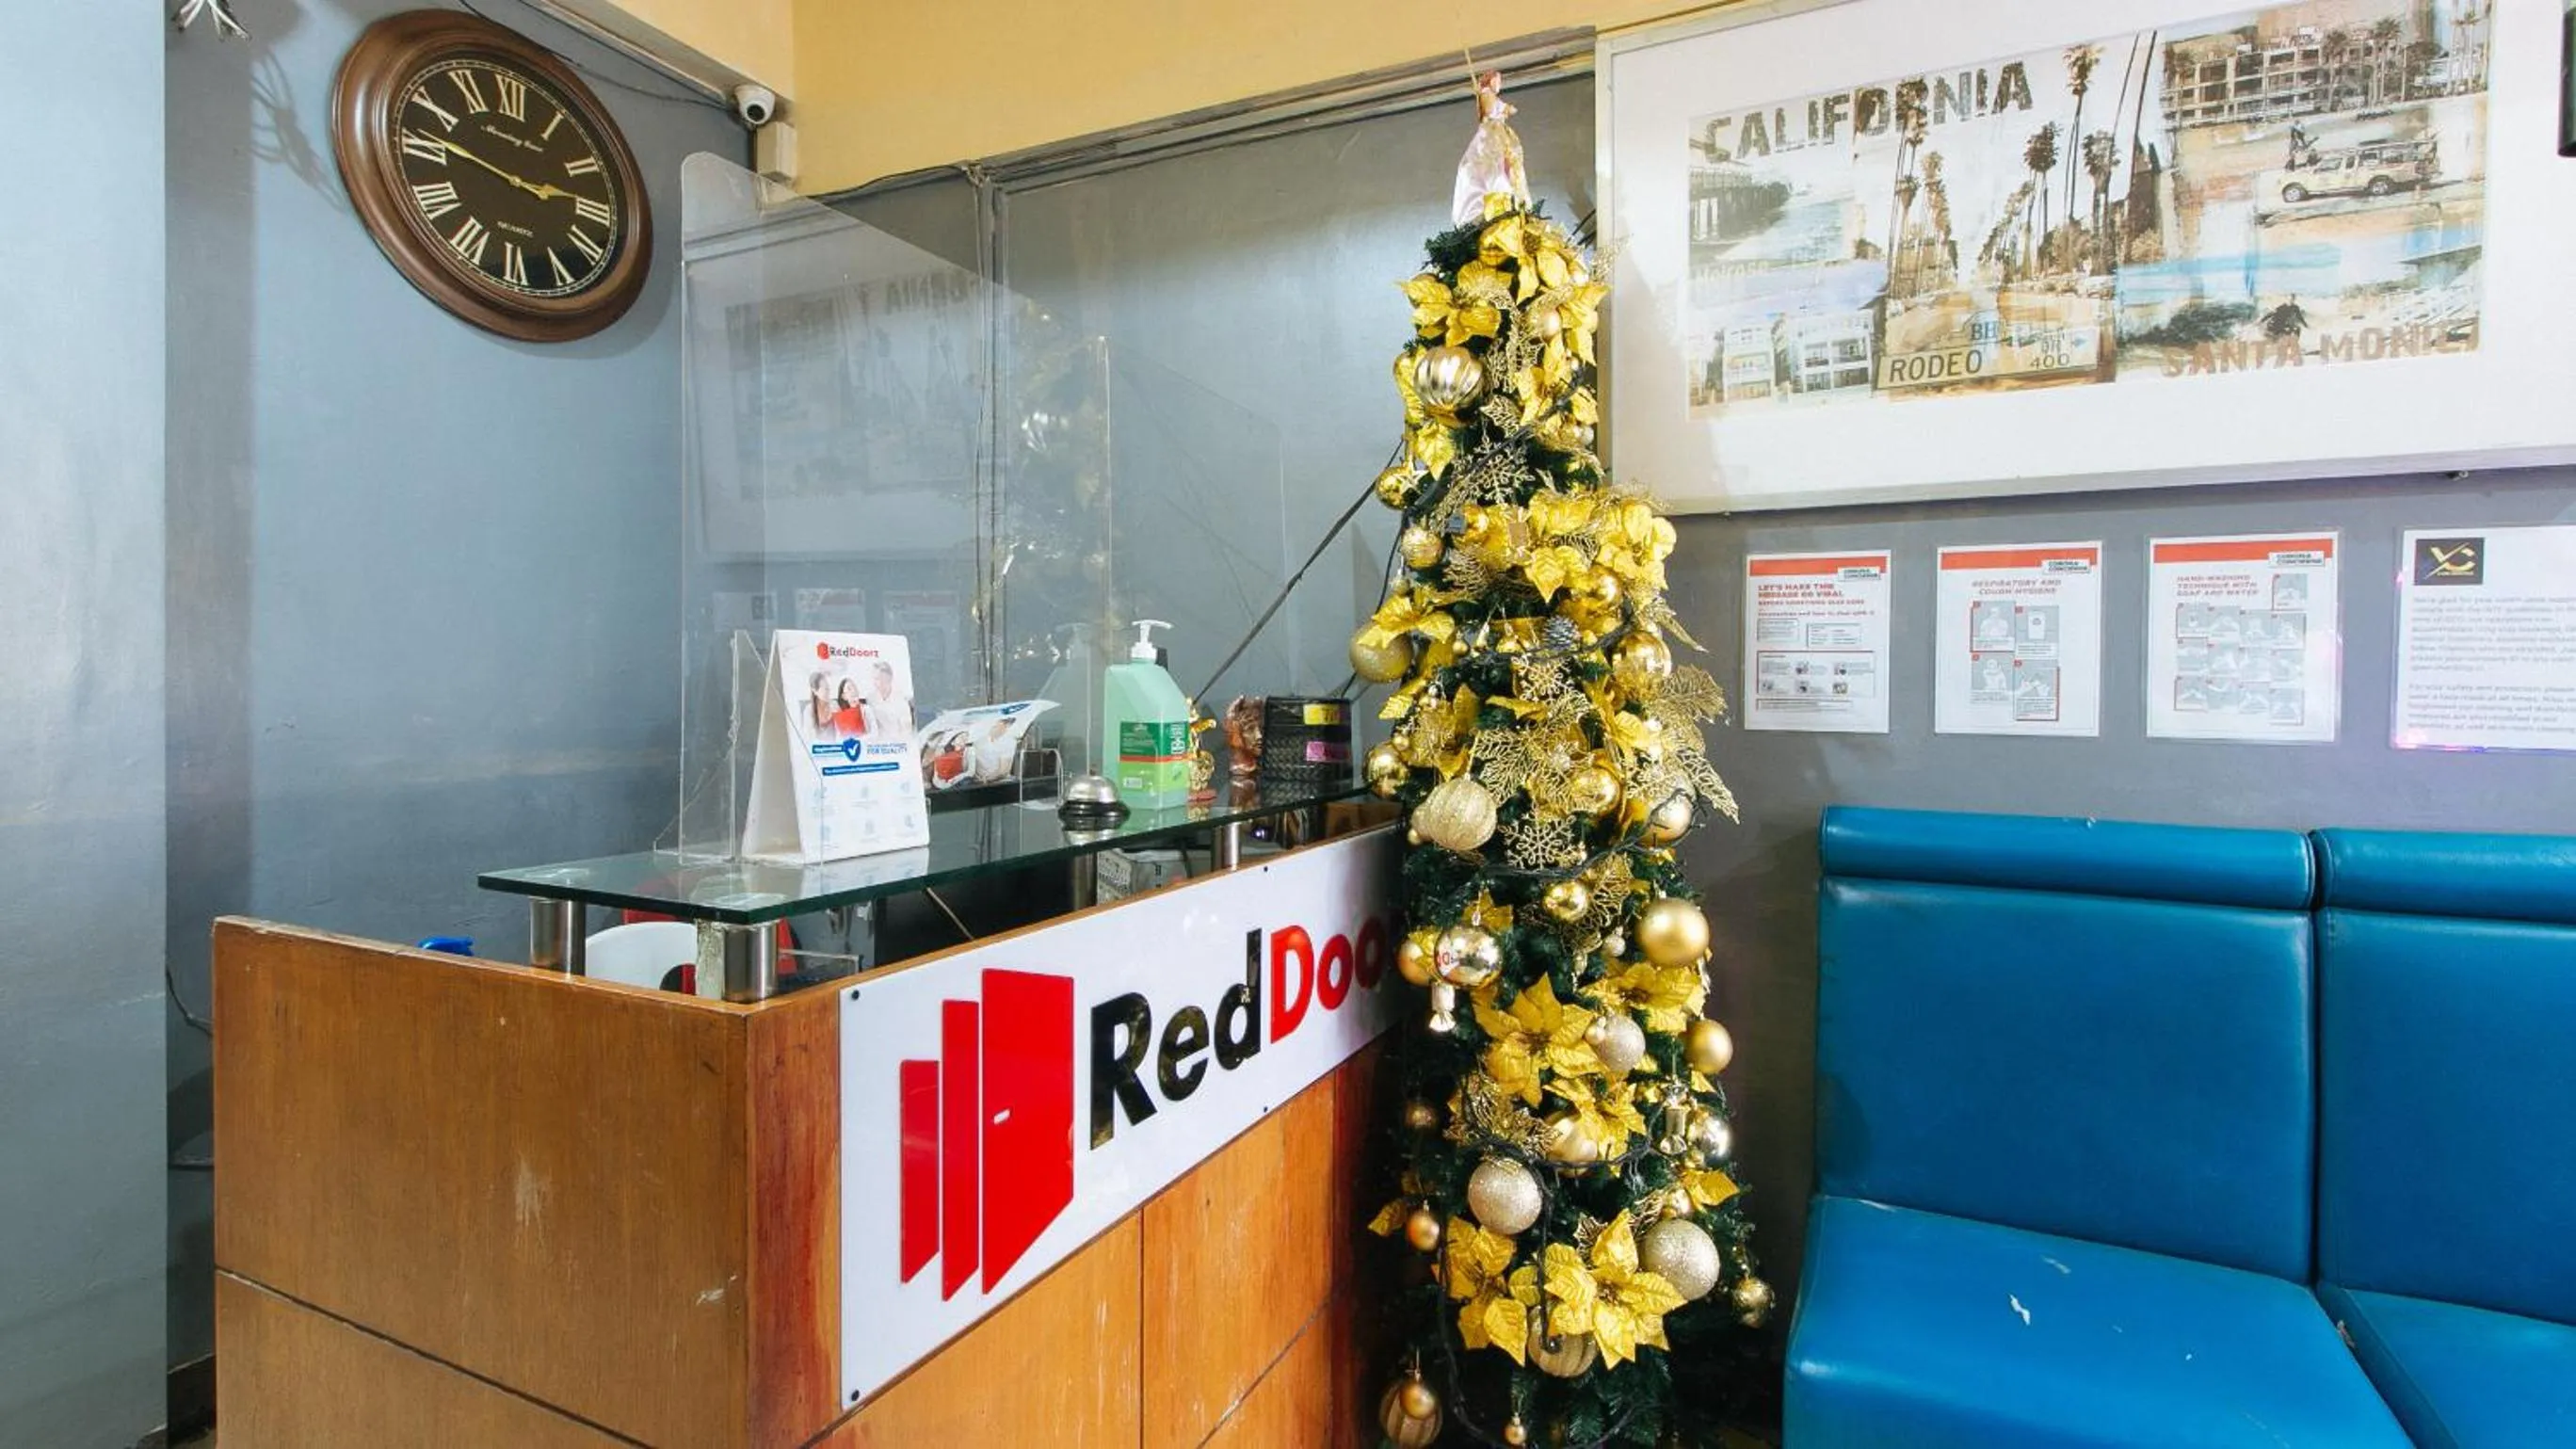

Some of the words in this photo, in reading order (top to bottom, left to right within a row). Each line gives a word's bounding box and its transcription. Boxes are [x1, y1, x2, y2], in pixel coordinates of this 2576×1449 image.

[411, 86, 459, 132] X
[447, 70, 490, 114] XI
[494, 73, 526, 121] XII
[1703, 61, 2034, 162] CALIFORNIA
[541, 108, 567, 140] I
[564, 156, 600, 177] II
[412, 182, 462, 220] VIII
[575, 196, 611, 227] III
[450, 217, 491, 266] VII
[503, 241, 528, 286] VI
[547, 247, 576, 286] V
[1889, 348, 1983, 382] RODEO
[2030, 353, 2070, 369] 400
[2162, 336, 2304, 378] SANTA
[1089, 917, 1385, 1151] RedDoo
